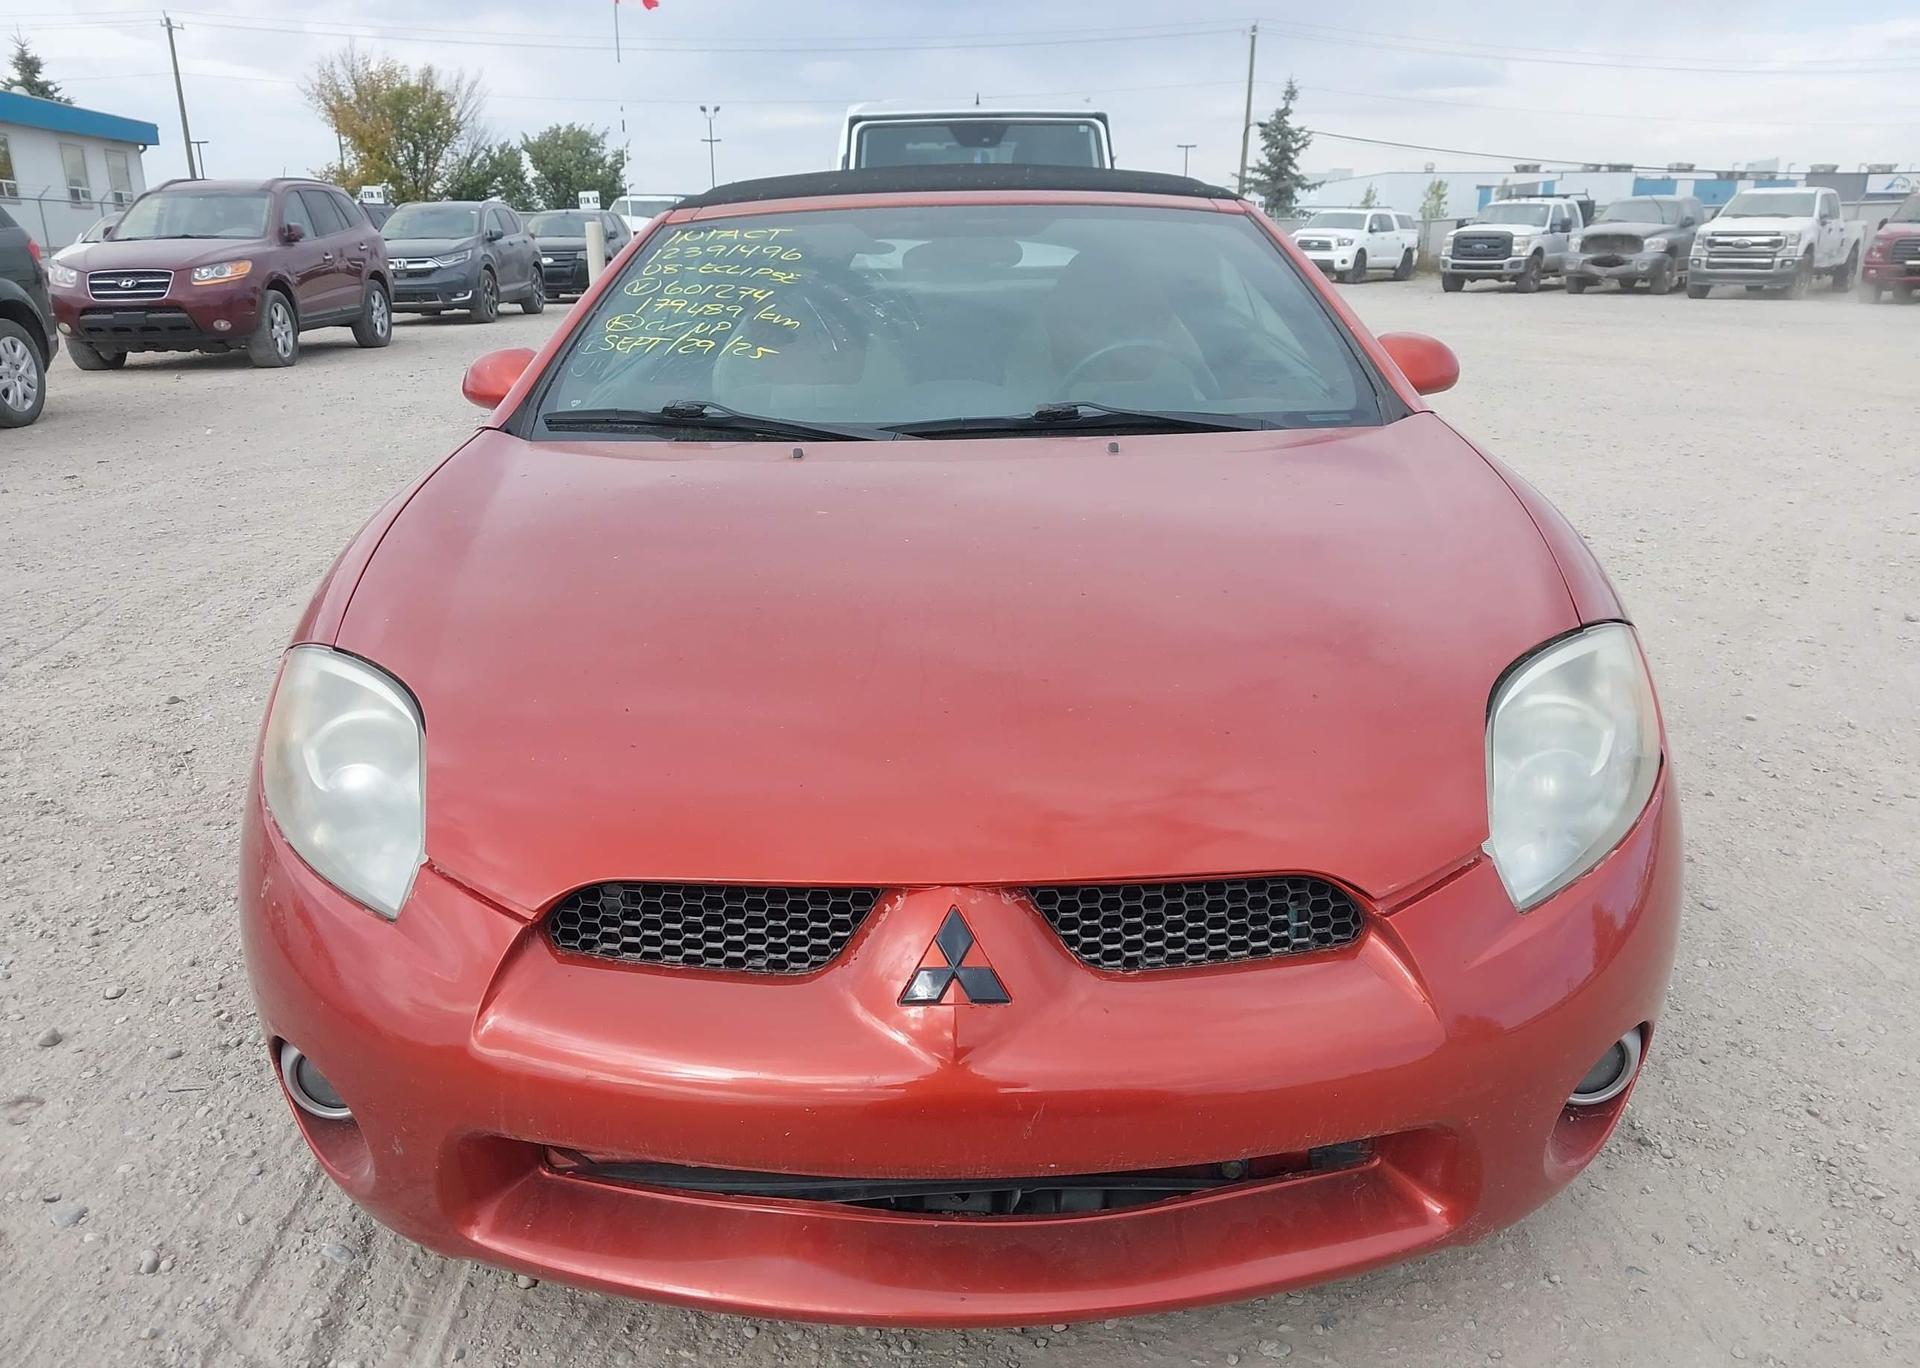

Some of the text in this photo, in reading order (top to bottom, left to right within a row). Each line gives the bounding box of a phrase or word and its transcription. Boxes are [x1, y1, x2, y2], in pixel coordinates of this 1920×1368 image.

[663, 229, 793, 247] INTACT
[647, 244, 802, 263] 12391496
[664, 281, 775, 303] 601274
[636, 297, 744, 318] 179489
